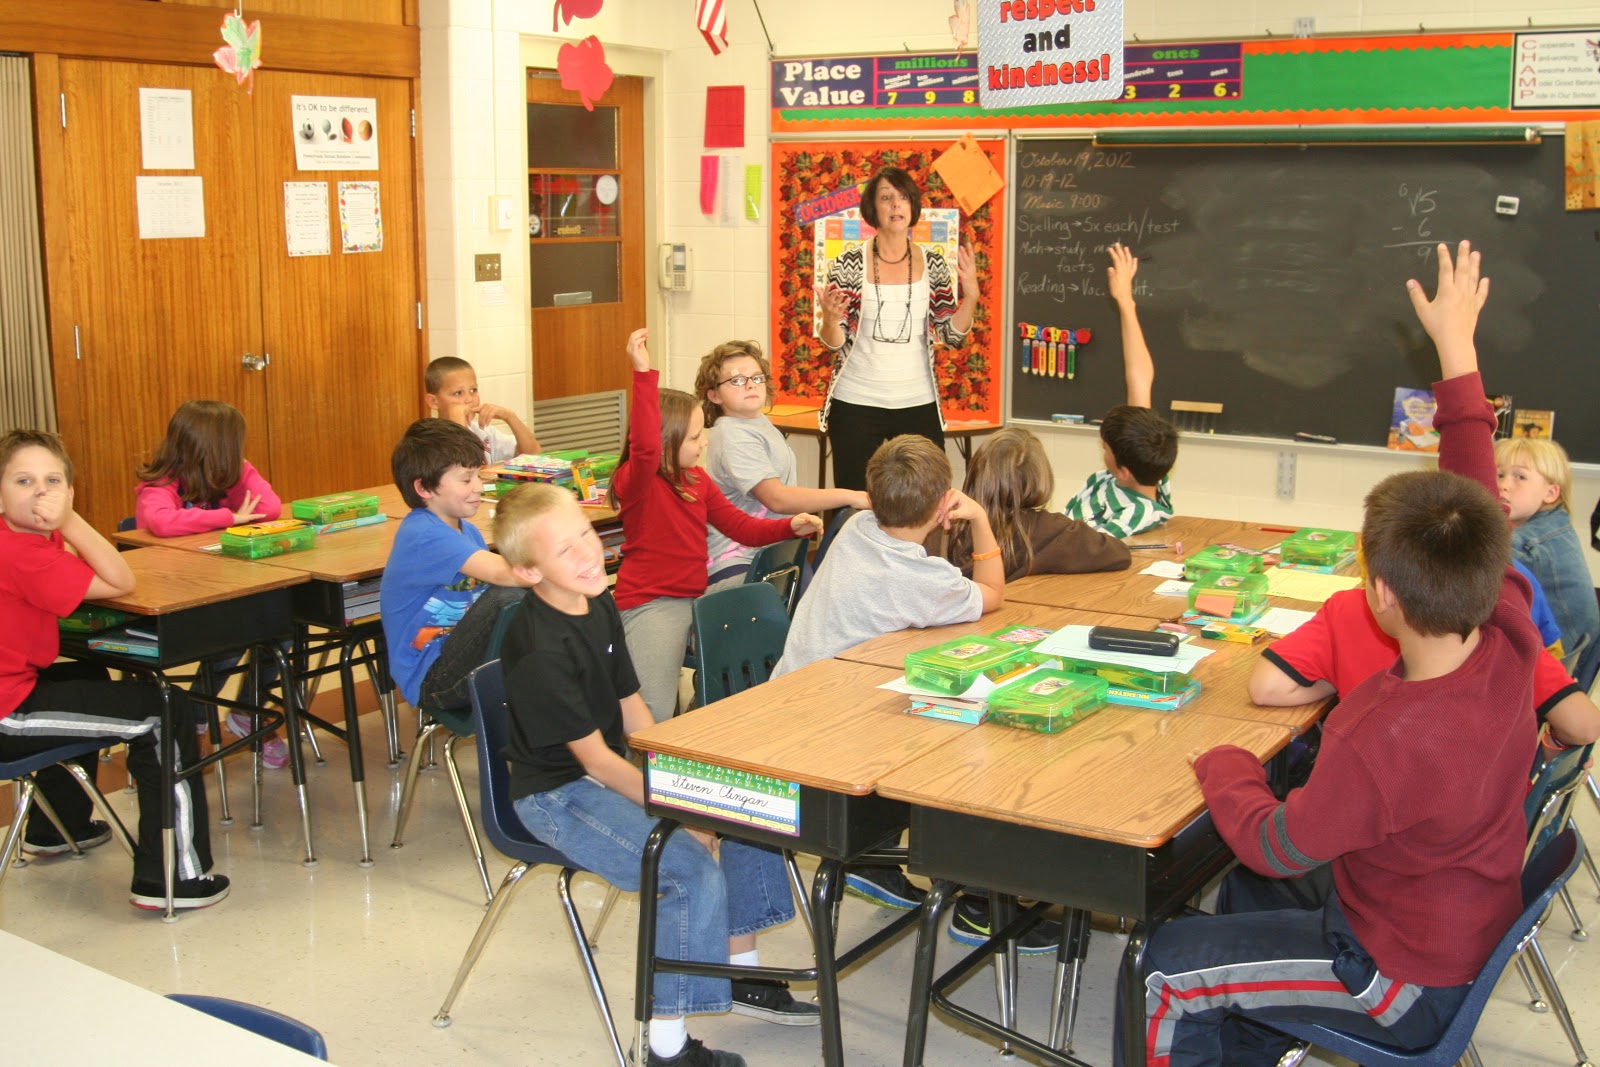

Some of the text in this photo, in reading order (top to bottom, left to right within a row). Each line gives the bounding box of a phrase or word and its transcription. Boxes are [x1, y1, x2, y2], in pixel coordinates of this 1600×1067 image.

[1000, 0, 1095, 23] respect
[1023, 24, 1071, 53] and
[895, 57, 968, 69] millions
[1152, 49, 1200, 60] ones
[784, 62, 861, 82] Place
[988, 53, 1111, 91] kindness!
[780, 86, 866, 106] Value
[887, 90, 975, 105] 7 9 8
[1124, 84, 1137, 99] 3
[1168, 83, 1182, 98] 2
[296, 103, 307, 111] It's
[308, 103, 318, 112] OK
[329, 104, 337, 112] be
[1020, 152, 1072, 168] October
[1094, 152, 1136, 168] 2012
[800, 186, 862, 221] OCTOBER
[1023, 193, 1065, 209] Music
[1017, 215, 1072, 240] Spelling
[1054, 241, 1085, 261] study
[1056, 256, 1096, 273] facts
[1017, 271, 1066, 303] Reading
[1018, 322, 1077, 345] TEACHER
[672, 774, 713, 795] Steven
[719, 785, 768, 808] Clingan
